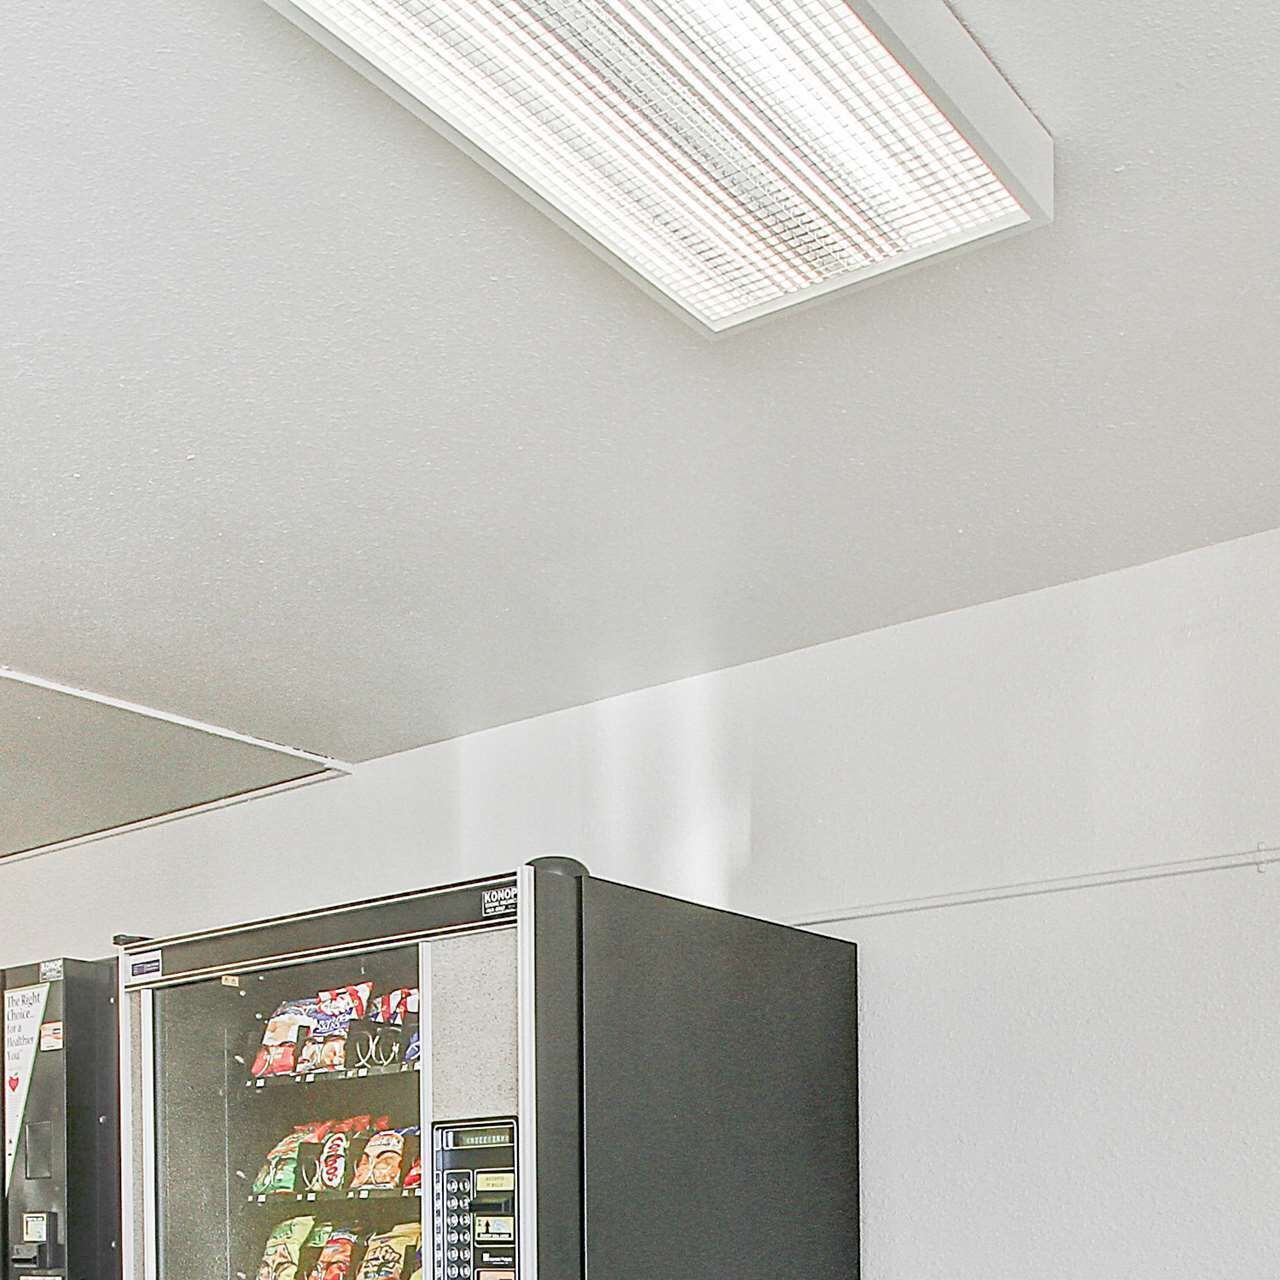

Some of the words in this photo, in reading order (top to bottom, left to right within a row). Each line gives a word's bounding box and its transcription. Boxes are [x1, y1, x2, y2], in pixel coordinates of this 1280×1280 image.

[484, 887, 517, 903] KONOP
[7, 995, 20, 1008] The
[21, 991, 41, 1009] Right
